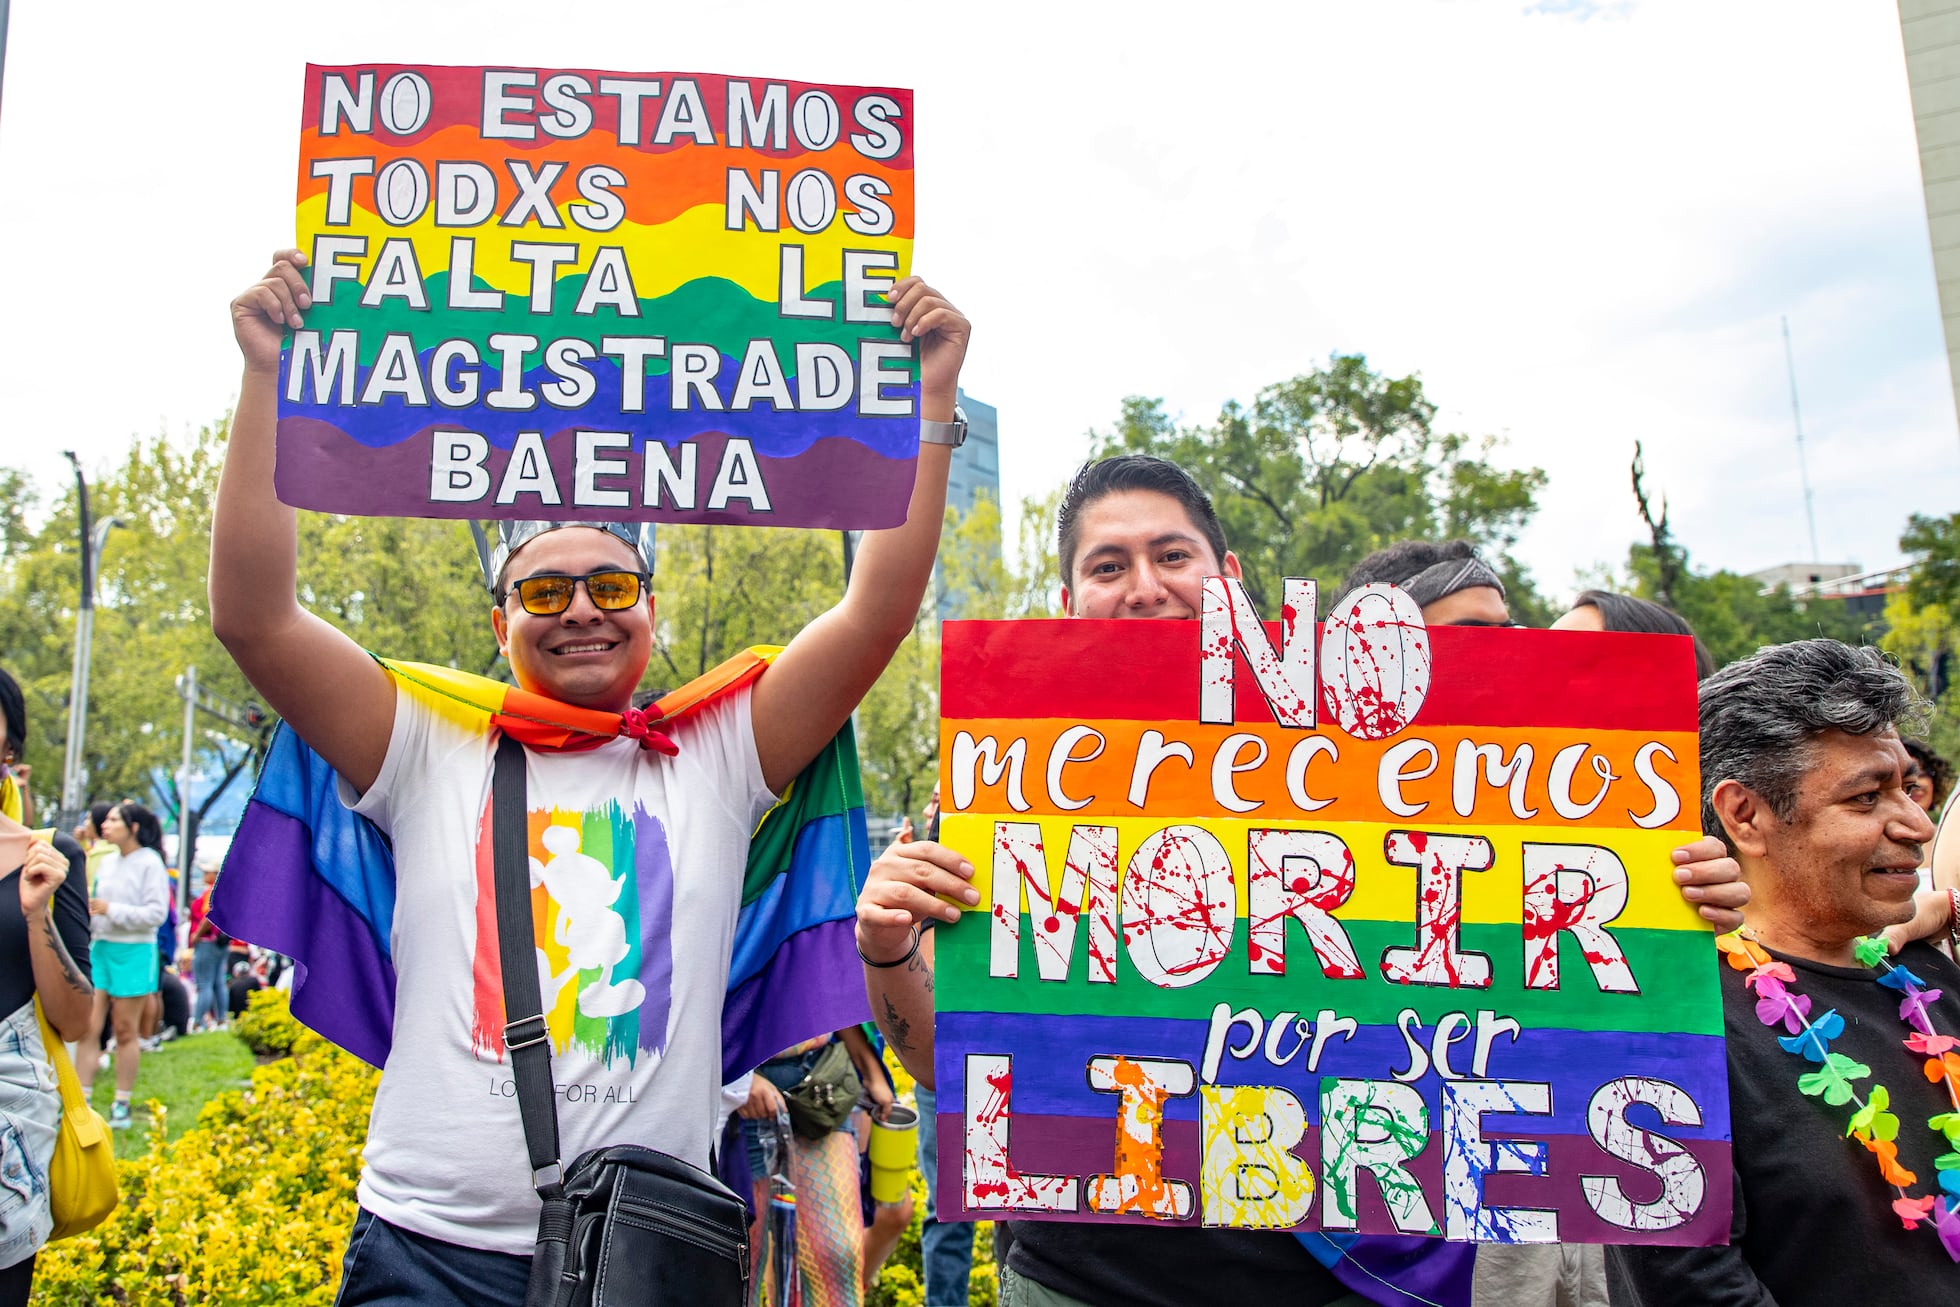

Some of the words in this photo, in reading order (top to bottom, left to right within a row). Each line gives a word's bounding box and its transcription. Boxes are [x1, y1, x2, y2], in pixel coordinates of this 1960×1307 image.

[319, 70, 433, 136] NO
[480, 69, 903, 161] ESTAMOS
[310, 156, 626, 232] TODXS
[725, 166, 894, 236] NOS
[311, 234, 641, 318] FALTA
[778, 244, 898, 323] LE
[287, 329, 914, 417] MAGISTRADE
[430, 431, 773, 512] BAENA
[1200, 576, 1432, 740] NO
[952, 724, 1681, 829] merecemos
[989, 821, 1641, 994] MORIR
[1202, 1001, 1358, 1084] por
[1391, 1007, 1520, 1082] ser
[554, 1084, 597, 1103] FOR
[603, 1085, 637, 1103] ALL
[963, 1053, 1705, 1244] LIBRES
